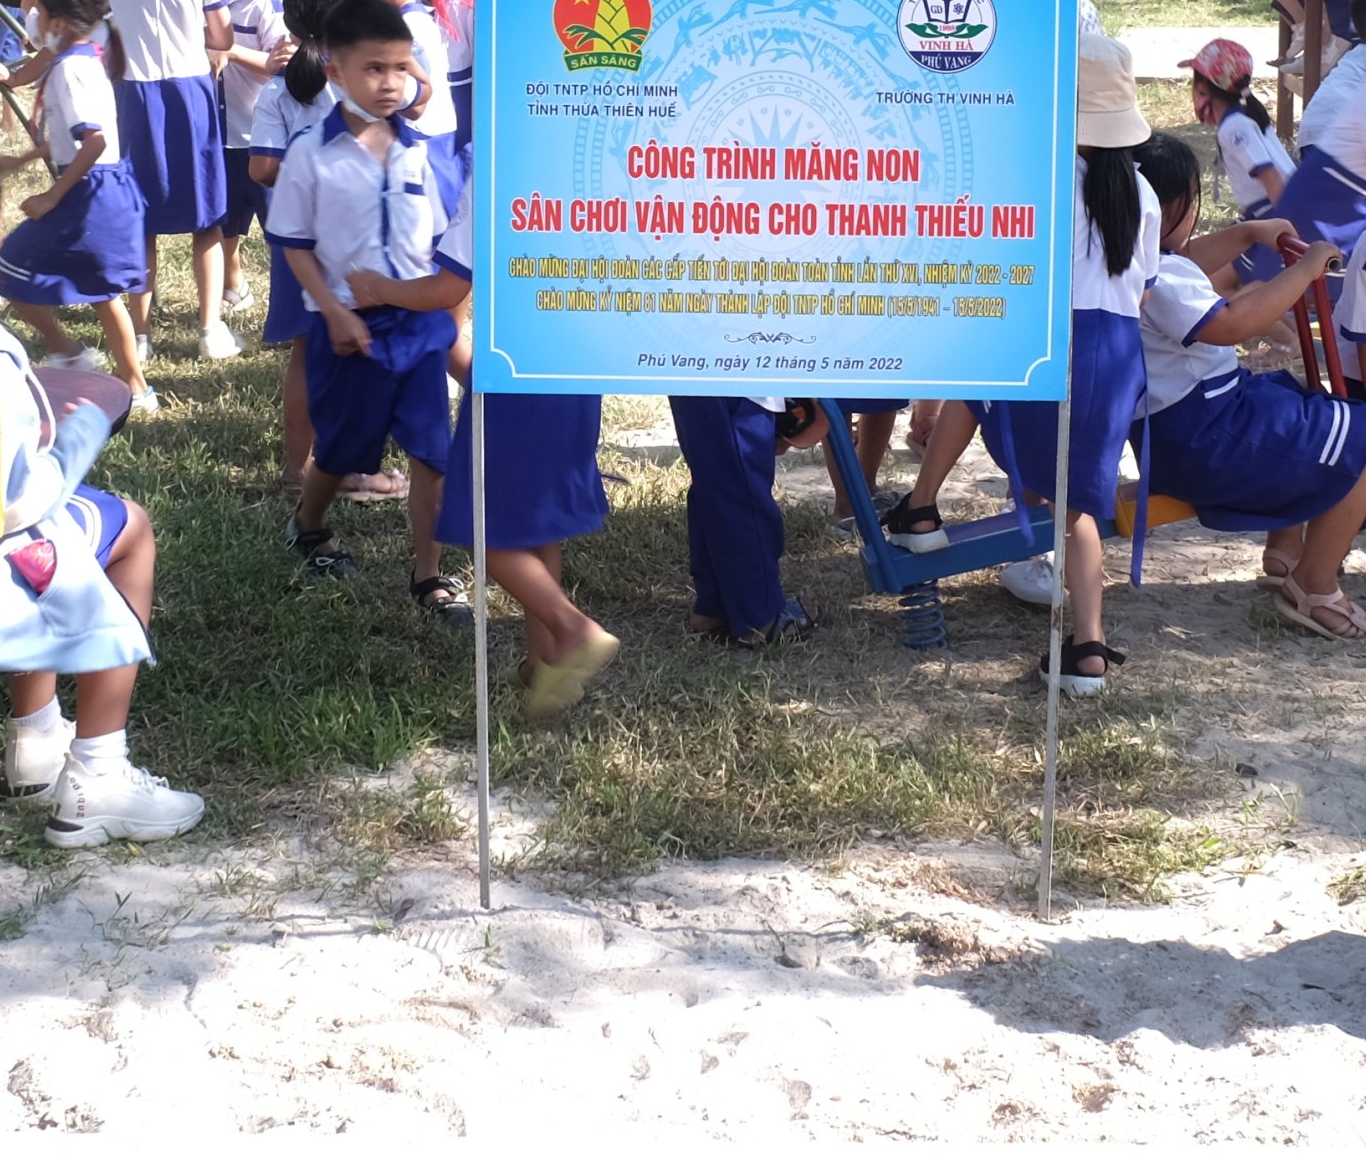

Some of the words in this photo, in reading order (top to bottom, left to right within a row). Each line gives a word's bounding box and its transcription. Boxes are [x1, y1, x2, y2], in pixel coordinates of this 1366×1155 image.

[919, 41, 952, 51] VINH
[955, 39, 974, 51] HÀ
[921, 53, 942, 69] PHÚ
[943, 55, 972, 69] VANG
[526, 81, 549, 97] ĐỘI
[553, 83, 588, 96] TNTP
[616, 82, 640, 96] CHÍ
[643, 85, 678, 97] MINH
[876, 89, 933, 104] TRƯỜNG
[937, 93, 955, 104] TH
[960, 93, 991, 104] VINH
[996, 90, 1015, 105] HÀ
[528, 100, 559, 116] TỈNH
[563, 102, 599, 116] THỪA
[604, 103, 644, 117] THIÊN
[648, 101, 677, 117] HUẾ
[628, 139, 695, 179] CÔNG
[703, 140, 776, 179] TRÌNH
[785, 141, 859, 181] MĂNG
[867, 149, 920, 182] NON
[511, 192, 562, 232] SÂN
[570, 197, 628, 232] CHƠI
[635, 194, 684, 241] VẬN
[692, 195, 760, 241] ĐỘNG
[768, 203, 818, 236] CHO
[825, 204, 907, 237] THANH
[915, 194, 984, 238] THIẾU
[991, 205, 1034, 238] NHI
[509, 253, 536, 278] CHÀO
[538, 253, 569, 278] MỪNG
[571, 258, 589, 283] ĐẠI
[591, 255, 609, 283] HỘI
[611, 255, 640, 279] ĐOÀN
[642, 255, 663, 280] CÁC
[665, 253, 686, 281] CẤP
[688, 253, 711, 281] TIẾN
[713, 256, 729, 281] TỚI
[731, 260, 749, 286] ĐẠI
[751, 257, 769, 286] HỘI
[771, 257, 800, 282] ĐOÀN
[802, 258, 829, 282] TOÀN
[832, 255, 855, 282] TỈNH
[901, 263, 921, 286] XVI,
[924, 259, 958, 288] NHIỆM
[975, 264, 1001, 284] 2022
[1009, 265, 1035, 285] 2027
[537, 286, 564, 311] CHÀO
[566, 286, 597, 311] MỪNG
[615, 287, 641, 316] NIỆM
[644, 292, 656, 312] 81
[659, 288, 683, 312] NĂM
[685, 289, 713, 313] NGÀY
[715, 289, 749, 313] THÀNH
[751, 289, 771, 319] LẬP
[773, 290, 791, 319] ĐỘI
[794, 295, 820, 315] TNTP
[857, 295, 885, 316] MINH
[638, 353, 666, 367] Phú
[671, 354, 709, 371] Vang,
[714, 356, 750, 372] ngày
[755, 356, 771, 369] 12
[775, 355, 816, 372] tháng
[820, 357, 829, 369] 5
[834, 356, 864, 370] năm
[868, 357, 903, 370] 2022
